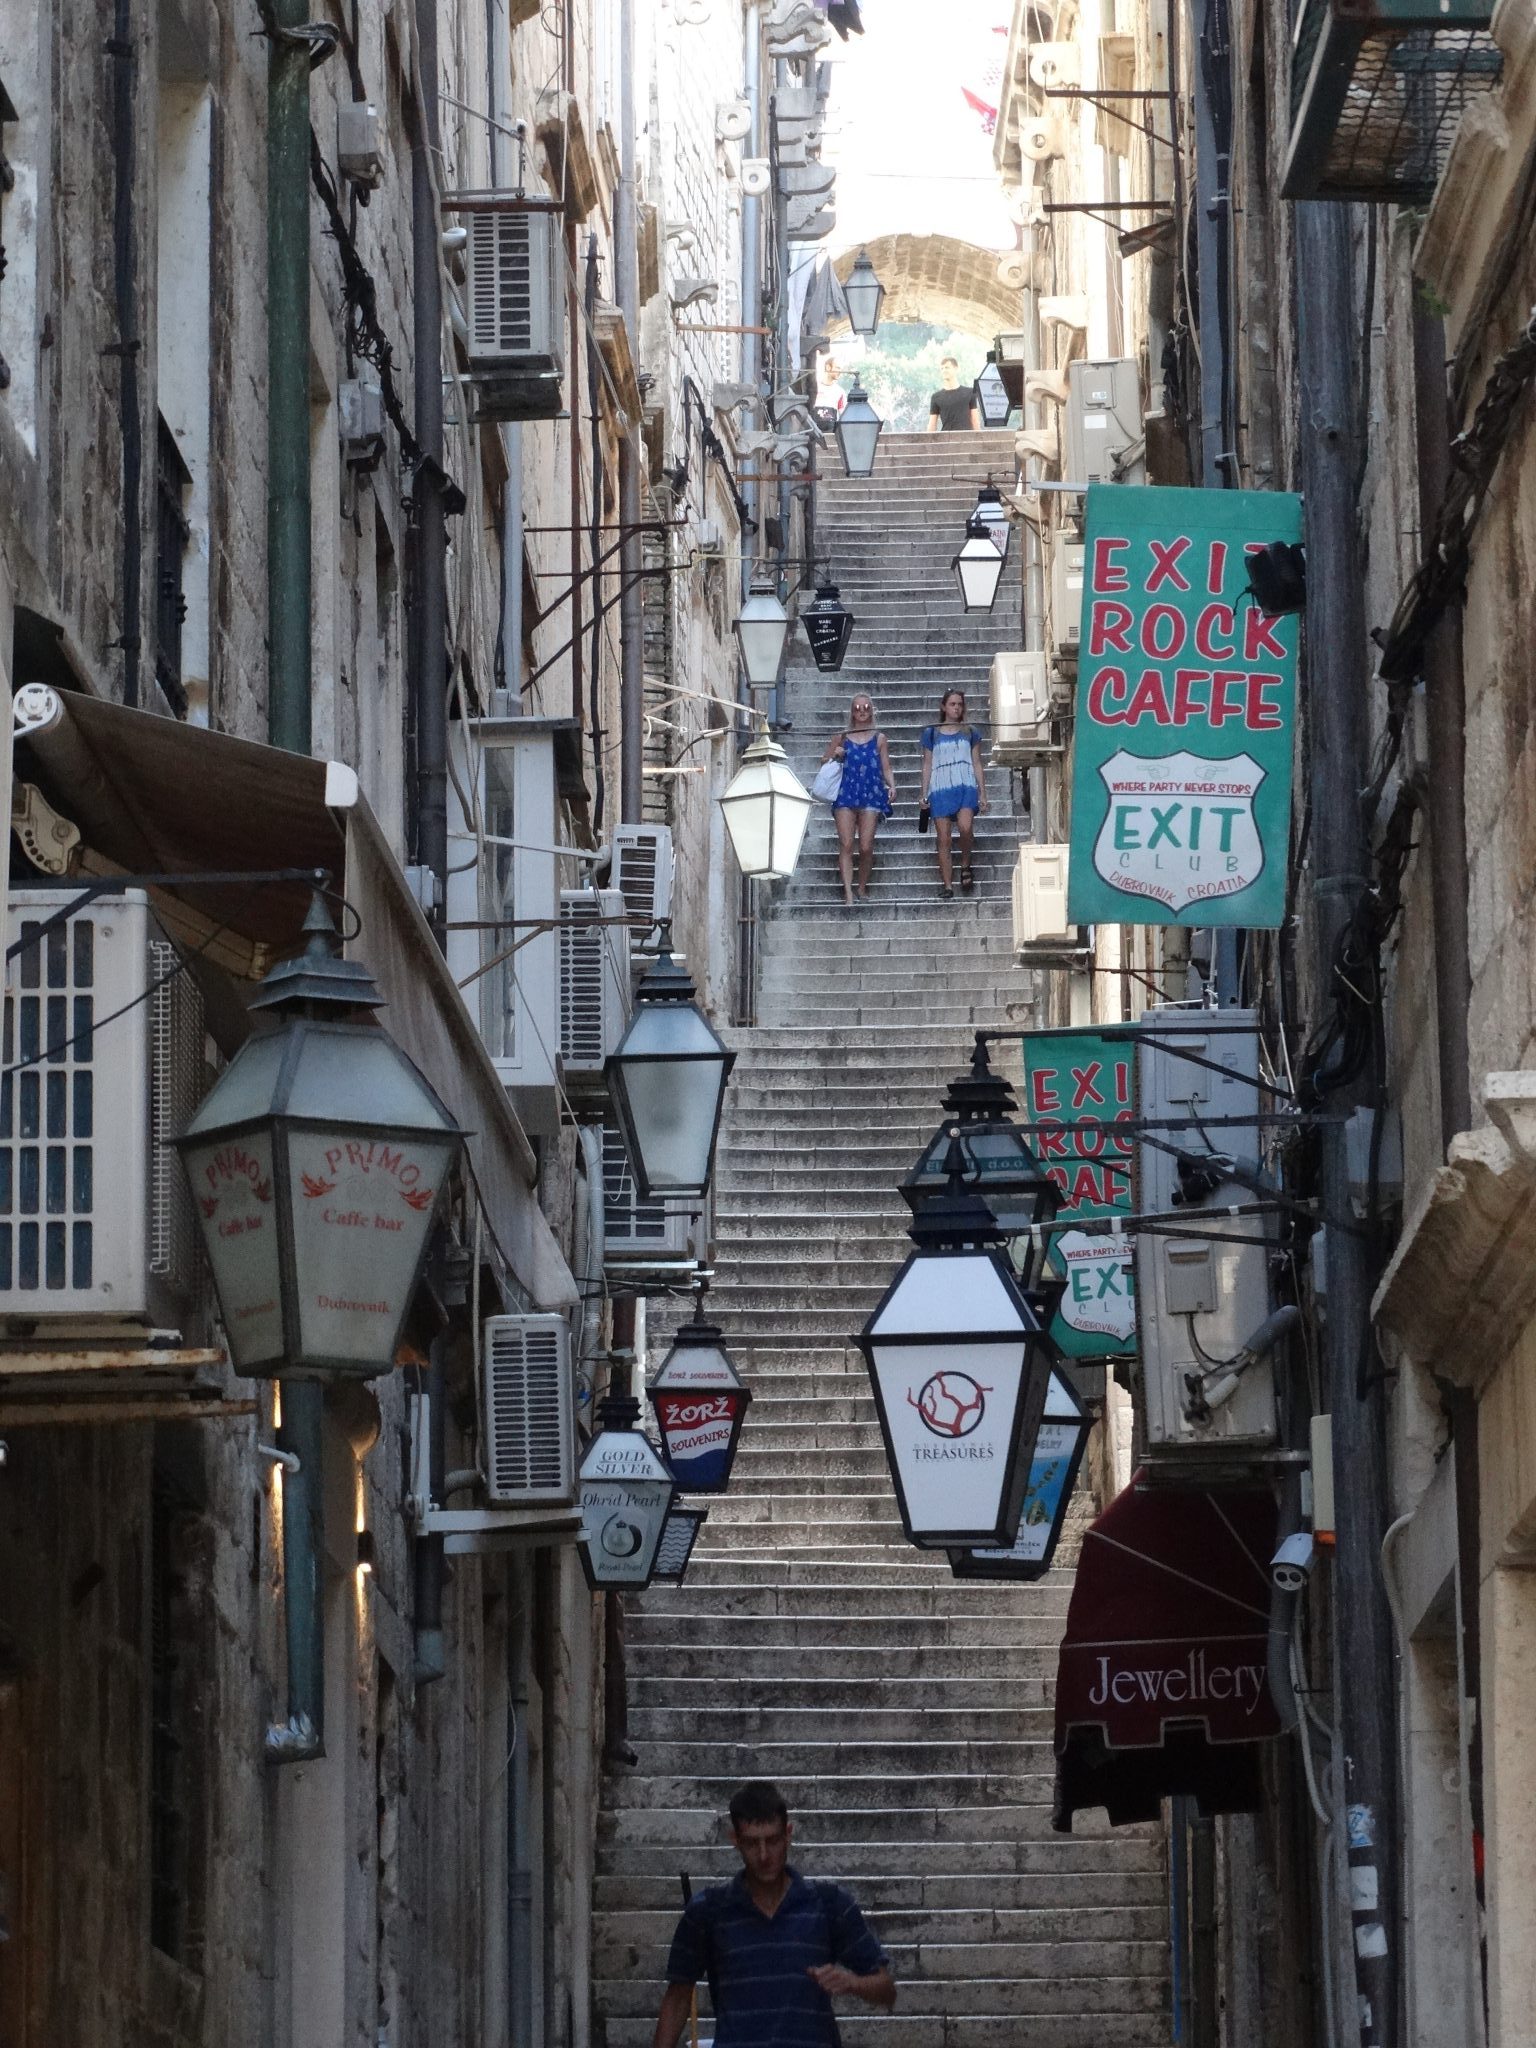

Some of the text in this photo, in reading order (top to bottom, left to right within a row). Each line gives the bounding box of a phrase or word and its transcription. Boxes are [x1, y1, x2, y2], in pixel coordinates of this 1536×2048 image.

[1091, 535, 1270, 595] EXI
[1088, 600, 1287, 661] ROCK
[1087, 666, 1283, 730] CAFFE
[1112, 782, 1251, 794] WHERE PARTY NEVER STOPS
[1114, 802, 1246, 853] EXIT
[1119, 852, 1239, 872] CLUB
[1109, 870, 1248, 903] DUBROVNIK CROATIA
[1031, 1061, 1129, 1113] EXI
[205, 1145, 260, 1190] PRIMO
[324, 1141, 421, 1186] PRIMO
[375, 1213, 404, 1232] bar
[1066, 1249, 1092, 1259] WHERE
[1093, 1247, 1117, 1257] PARTY
[317, 1295, 390, 1315] Dubrovnik
[1073, 1316, 1121, 1335] DUBROVNIK
[665, 1396, 730, 1425] ŽORŽ
[670, 1428, 730, 1454] SOUVENIRS
[912, 1446, 994, 1460] TREASURES
[595, 1463, 652, 1475] SILVER
[602, 1450, 645, 1462] GOLD
[583, 1491, 661, 1507] Ohrid Pearl
[1089, 1649, 1267, 1715] Jewellery
